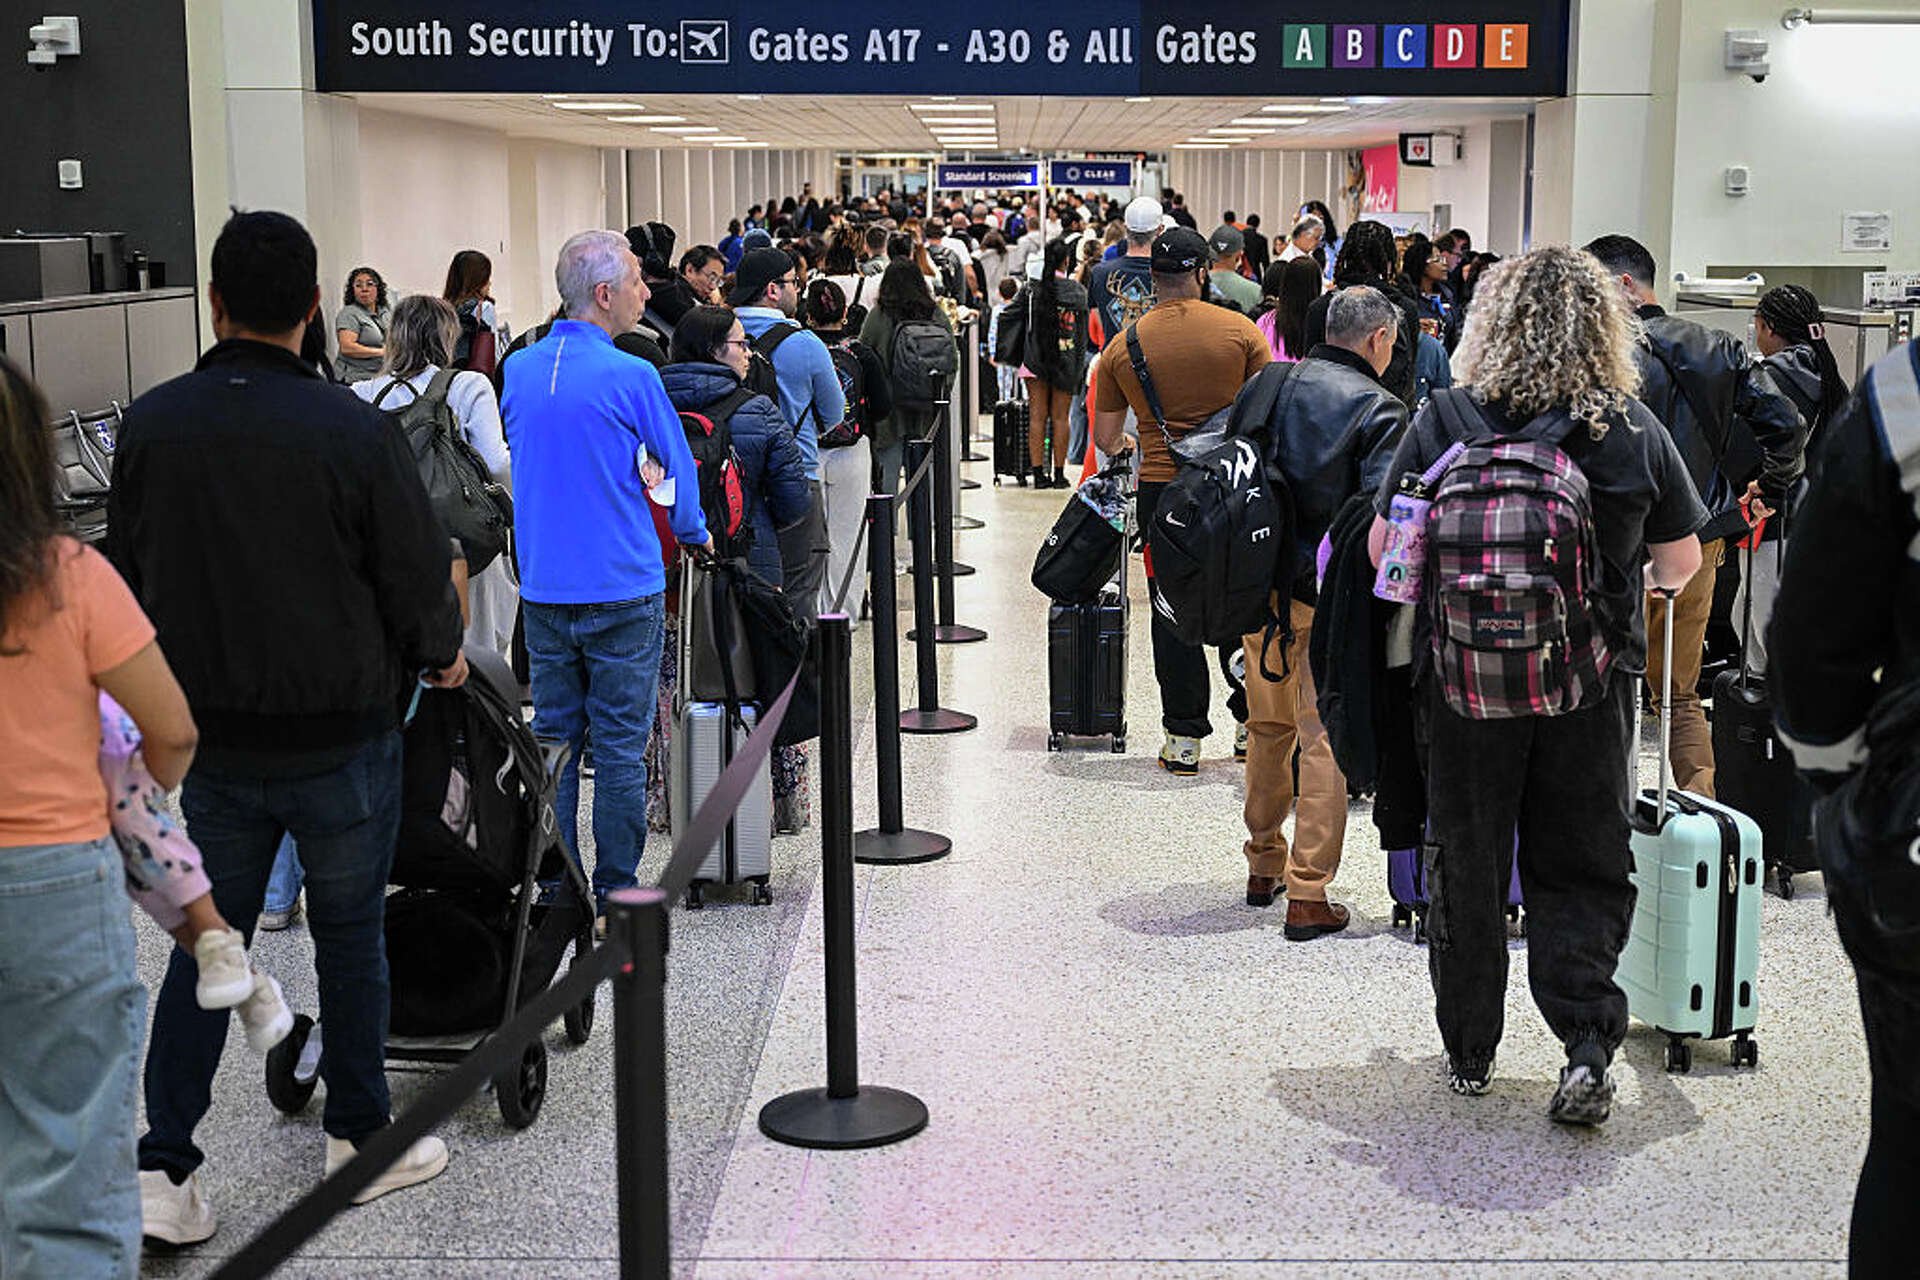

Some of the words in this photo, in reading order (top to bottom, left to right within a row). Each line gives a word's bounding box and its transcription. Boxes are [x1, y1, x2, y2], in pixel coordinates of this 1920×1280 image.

[352, 21, 452, 56] South
[468, 21, 614, 66] Security
[628, 23, 679, 57] To:
[749, 28, 849, 62] Gates
[864, 30, 921, 62] A17
[937, 43, 949, 52] -
[966, 30, 1030, 63] A30
[1047, 29, 1070, 63] &
[1085, 28, 1133, 63] All
[1156, 24, 1257, 64] Gates
[1296, 28, 1313, 60] A
[1347, 29, 1362, 60] B
[1398, 29, 1413, 60] C
[1447, 29, 1463, 60] D
[1500, 29, 1513, 60] E
[944, 171, 985, 182] Standard
[987, 171, 1032, 184] Screening
[1084, 169, 1116, 179] CLEAR
